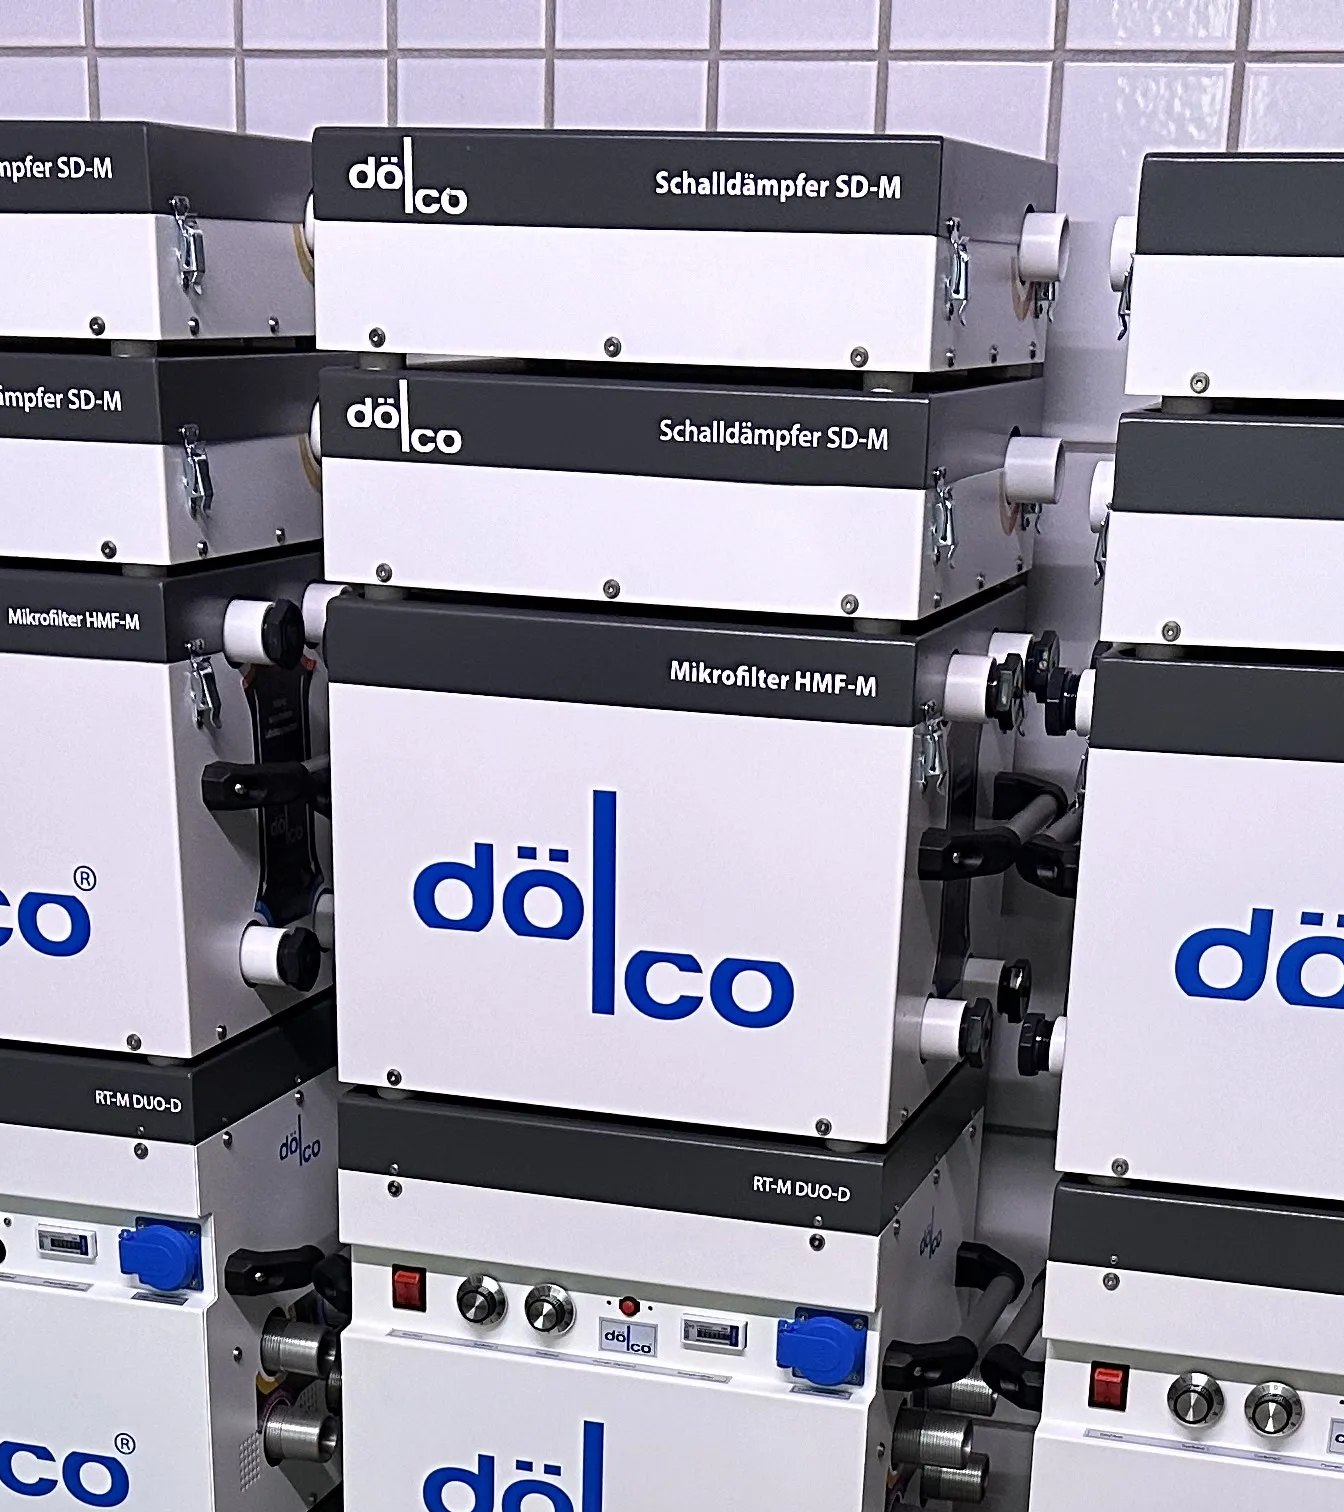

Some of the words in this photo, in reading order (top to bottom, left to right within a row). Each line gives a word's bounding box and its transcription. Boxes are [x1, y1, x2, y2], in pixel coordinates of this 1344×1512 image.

[58, 157, 112, 178] SD-M
[349, 137, 467, 214] dölco
[656, 171, 829, 202] Schalldämpfer
[836, 175, 900, 199] SD-M
[68, 389, 121, 411] SD-M
[347, 379, 461, 453] dölco
[660, 419, 821, 451] Schalldämpfer
[827, 427, 887, 450] SD-M
[9, 608, 83, 627] Mikrofilter
[86, 612, 139, 630] HMF-M
[671, 661, 789, 689] Mikrofilter
[795, 671, 876, 697] HMF-M
[414, 790, 794, 1028] dölco
[96, 1090, 129, 1107] RT-M
[133, 1094, 181, 1112] DUO-D
[279, 1114, 321, 1166] dölco
[754, 1176, 791, 1195] RT-M
[796, 1182, 850, 1201] DUO-D
[605, 1326, 651, 1353] dölco
